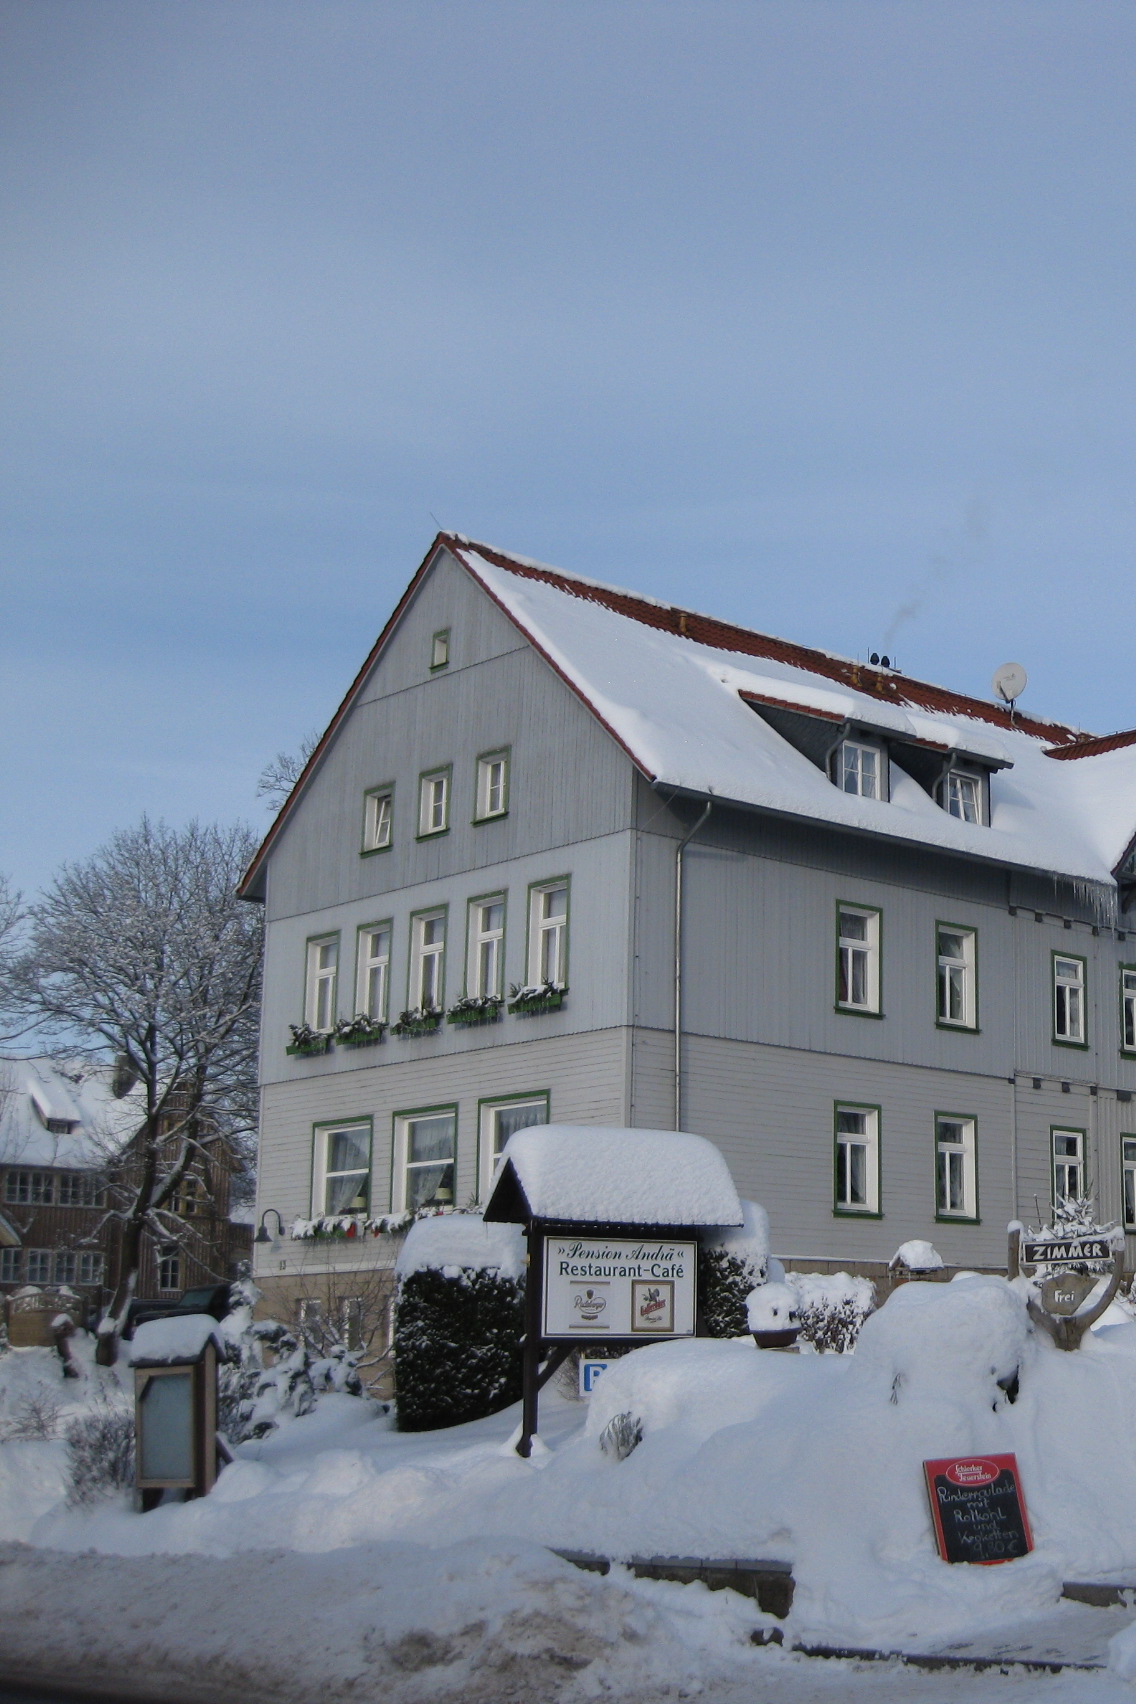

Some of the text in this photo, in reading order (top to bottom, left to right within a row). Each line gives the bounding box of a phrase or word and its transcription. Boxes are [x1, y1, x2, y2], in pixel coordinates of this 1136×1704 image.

[1033, 1243, 1103, 1260] ZIMMER
[559, 1261, 684, 1278] Restaurant-Café
[1054, 1289, 1075, 1303] Frei
